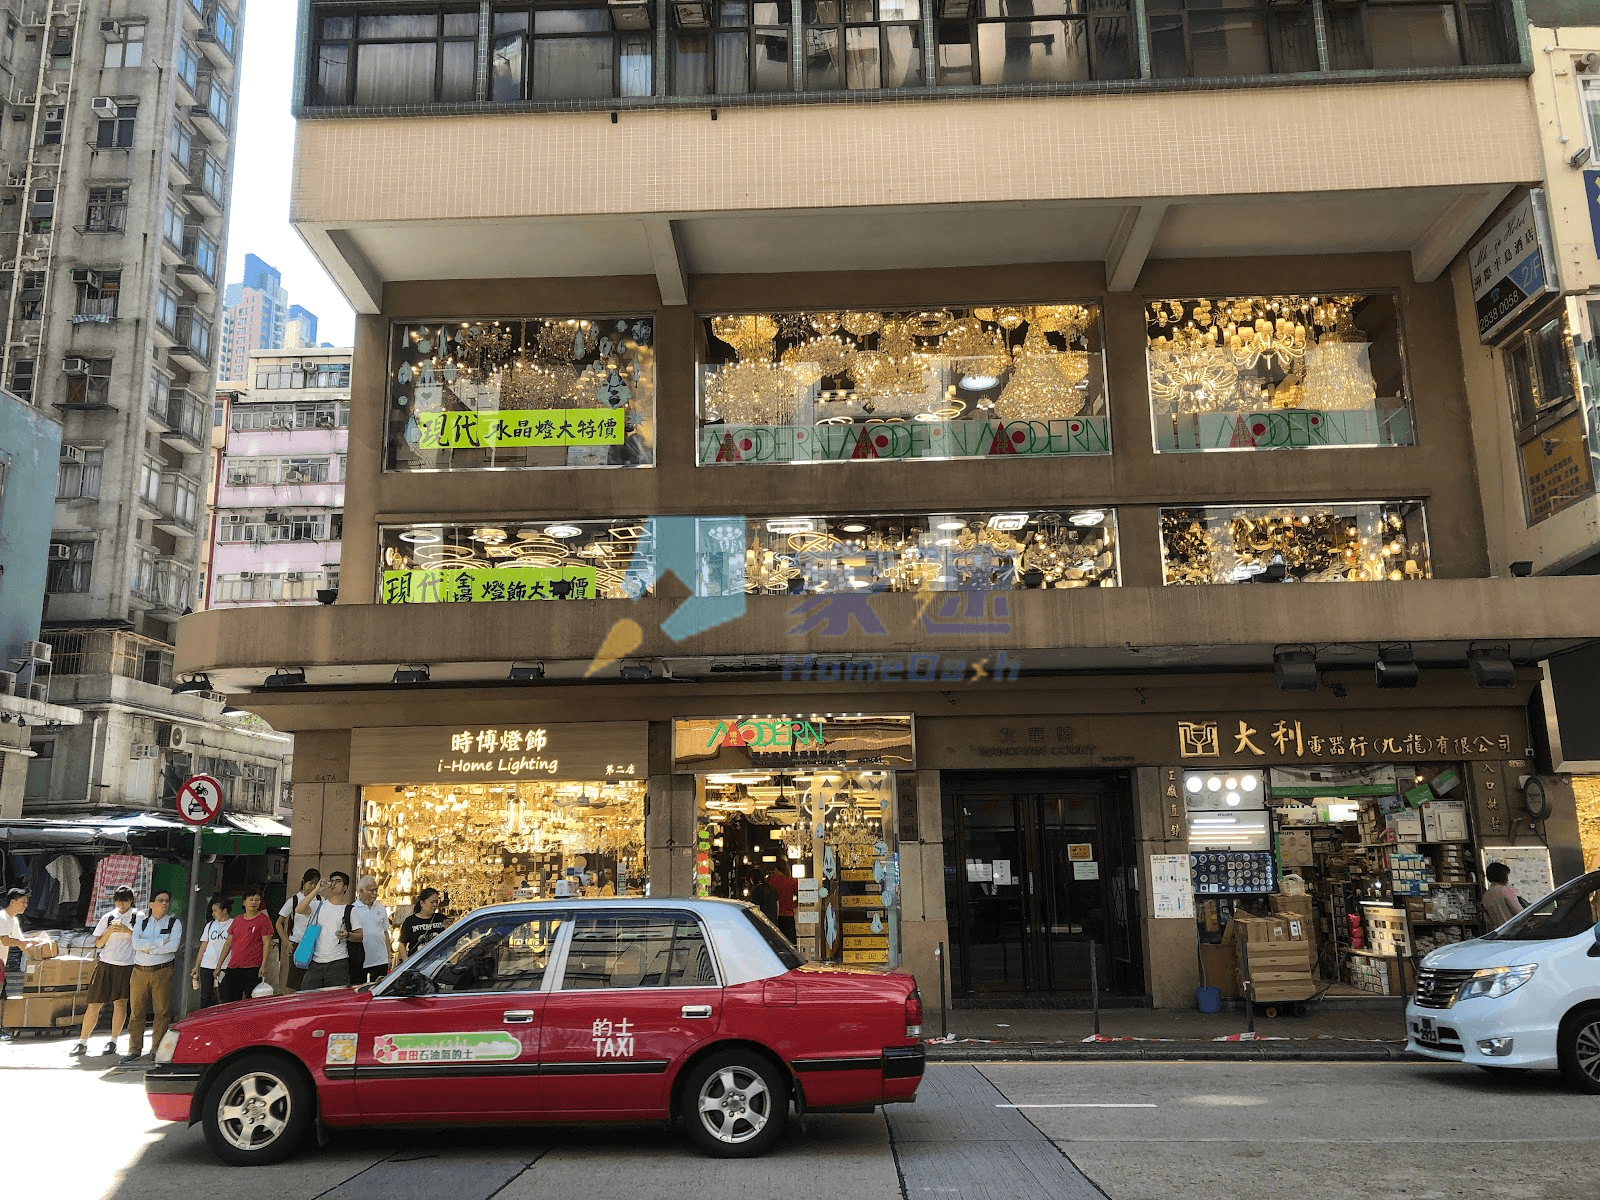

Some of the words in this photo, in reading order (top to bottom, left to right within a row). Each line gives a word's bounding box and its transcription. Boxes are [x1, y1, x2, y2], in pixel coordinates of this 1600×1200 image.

[1521, 254, 1541, 289] 2/F
[1480, 308, 1498, 332] 2838
[1500, 290, 1519, 318] 0058
[838, 423, 967, 459] MODERN
[975, 418, 1109, 455] MODERN
[1215, 412, 1347, 447] MODERN
[701, 426, 830, 462] MODERN
[383, 571, 589, 603] 現代全場燈飾大價
[450, 728, 548, 753] 時博燈飾
[706, 721, 824, 747] MODERN
[1050, 744, 1096, 756] COURT
[315, 774, 337, 782] 647A
[438, 758, 493, 773] i-Home
[498, 757, 558, 773] Lighting
[604, 763, 635, 775] 第二店
[592, 1017, 635, 1037] 的士
[592, 1038, 635, 1058] TAXI
